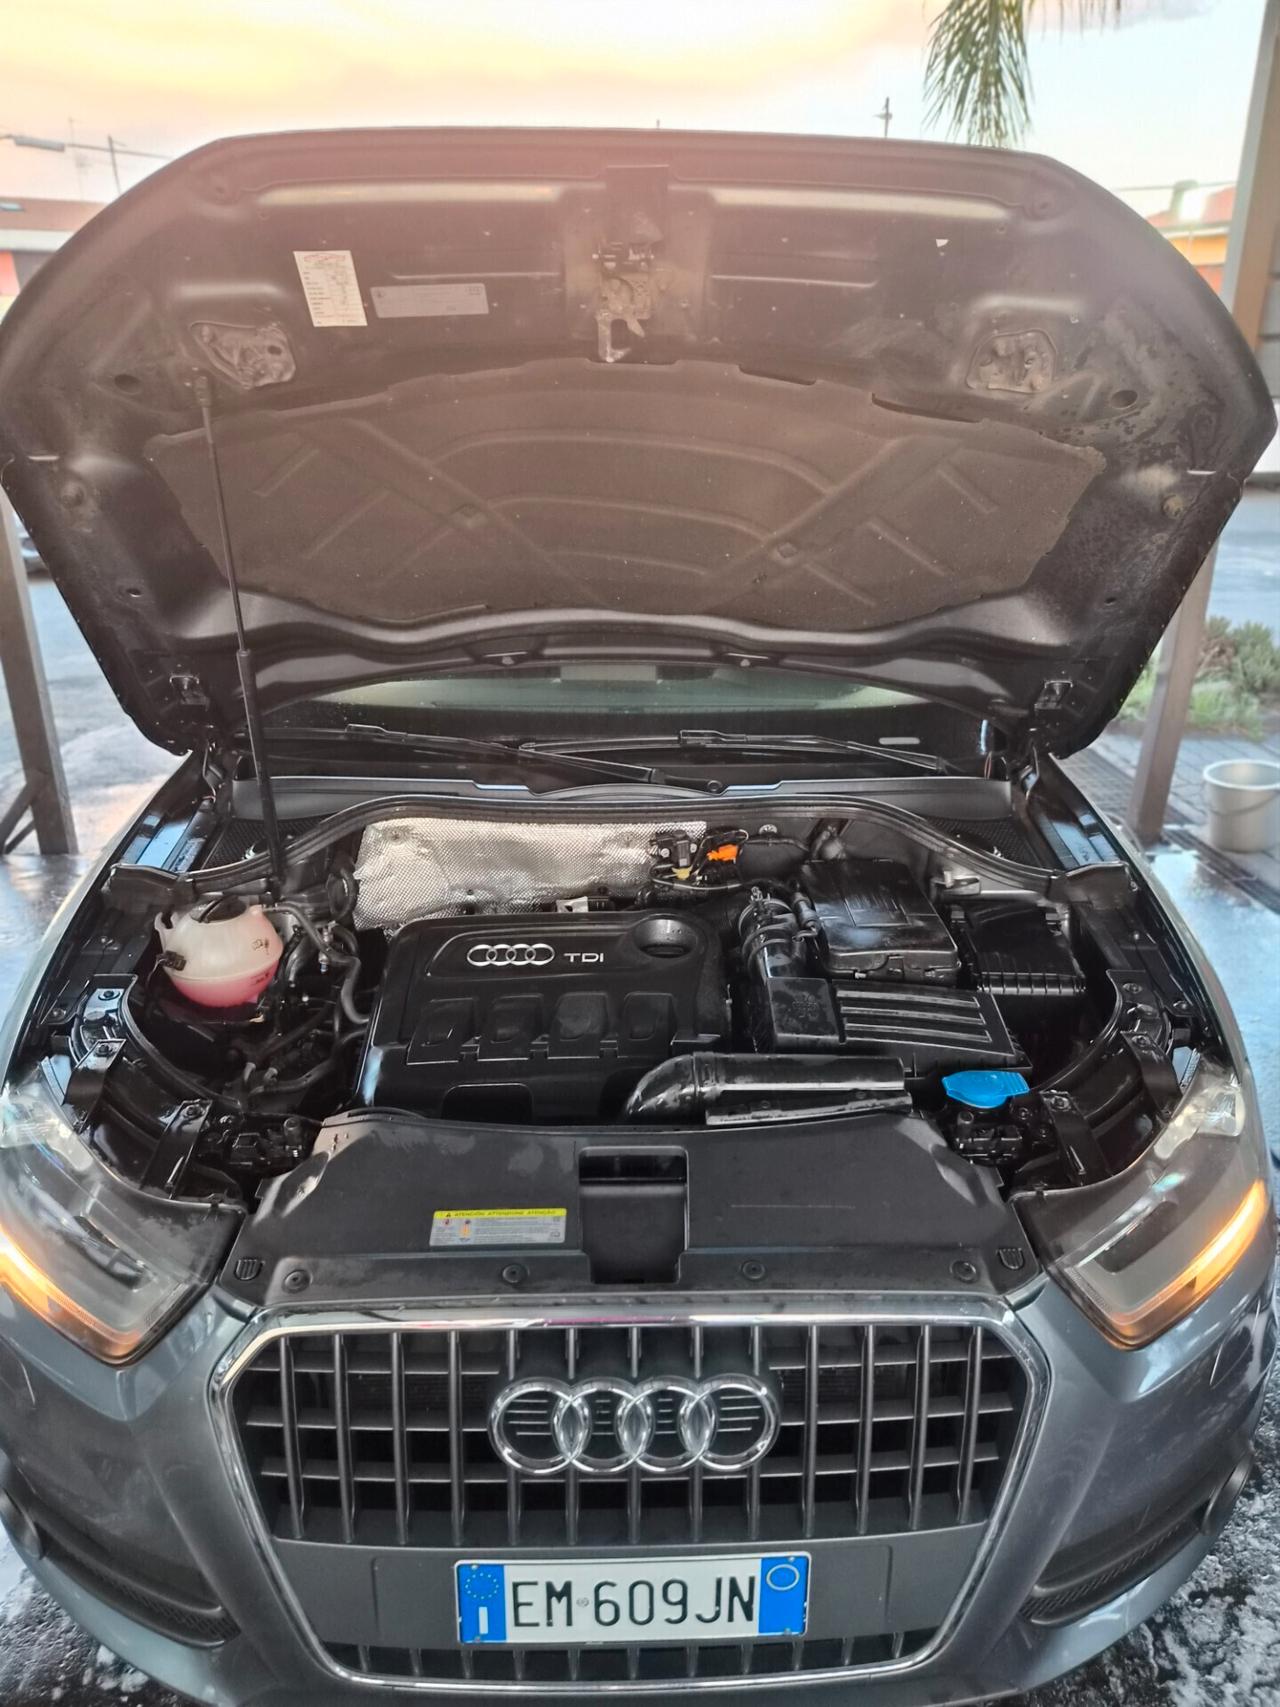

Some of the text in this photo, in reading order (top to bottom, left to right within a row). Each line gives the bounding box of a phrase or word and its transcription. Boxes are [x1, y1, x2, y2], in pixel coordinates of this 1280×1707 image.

[564, 952, 604, 963] TDI
[512, 1580, 573, 1627] EM
[479, 1606, 489, 1635] I
